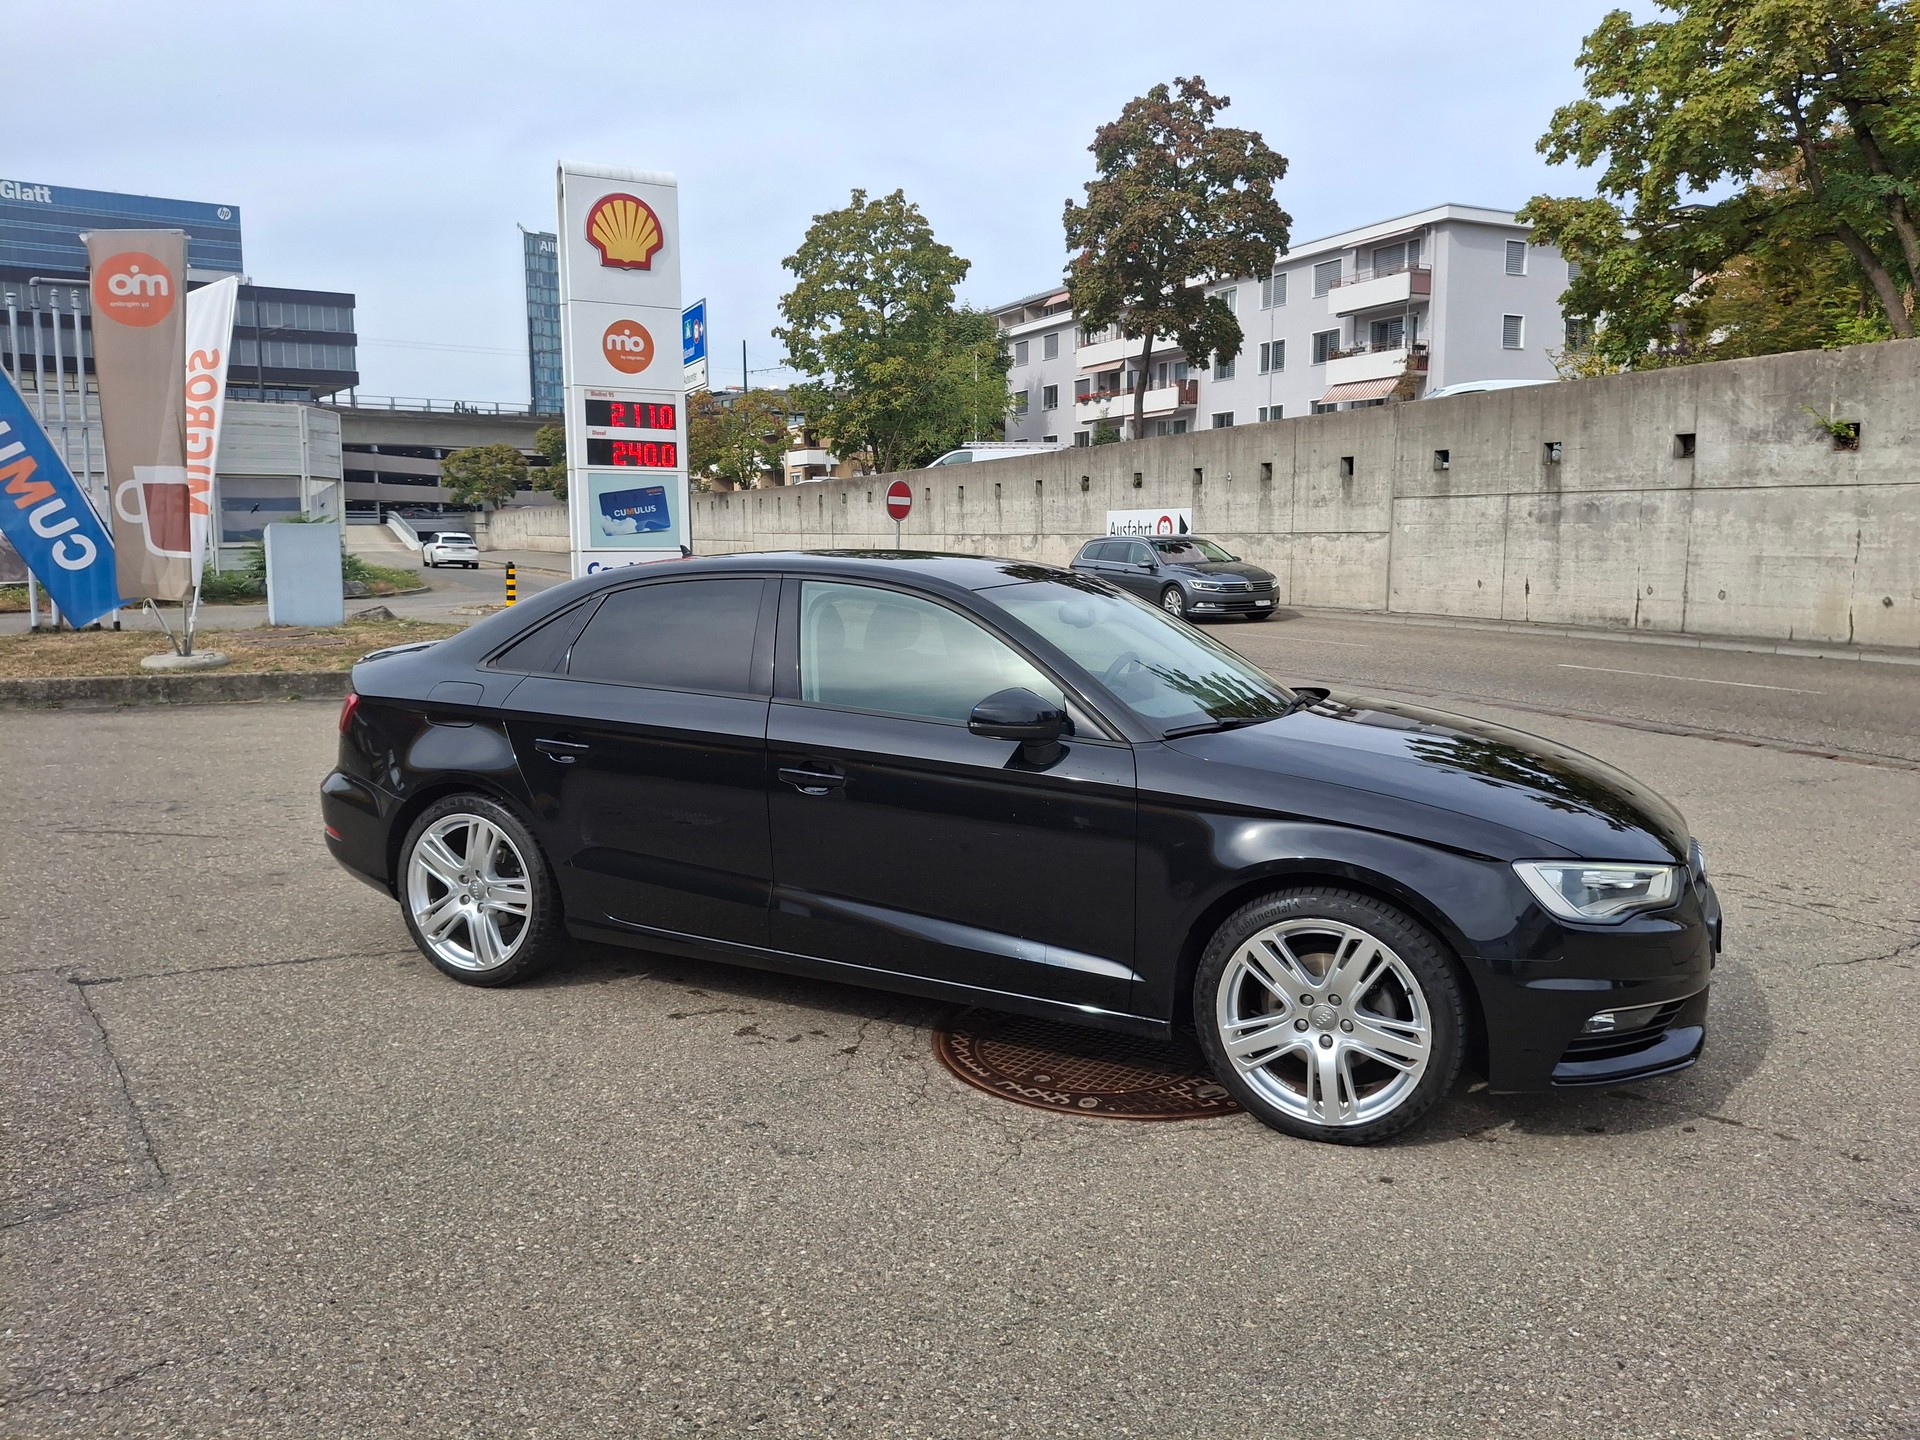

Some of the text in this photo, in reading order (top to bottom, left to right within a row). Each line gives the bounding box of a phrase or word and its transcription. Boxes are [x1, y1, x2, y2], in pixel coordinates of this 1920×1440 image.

[0, 180, 52, 204] Glatt
[218, 207, 230, 220] hp
[606, 329, 645, 353] mio
[611, 402, 674, 429] 211.0
[613, 441, 675, 468] 240.0
[614, 505, 657, 517] CUMULUS
[1110, 520, 1152, 536] Ausfahrt
